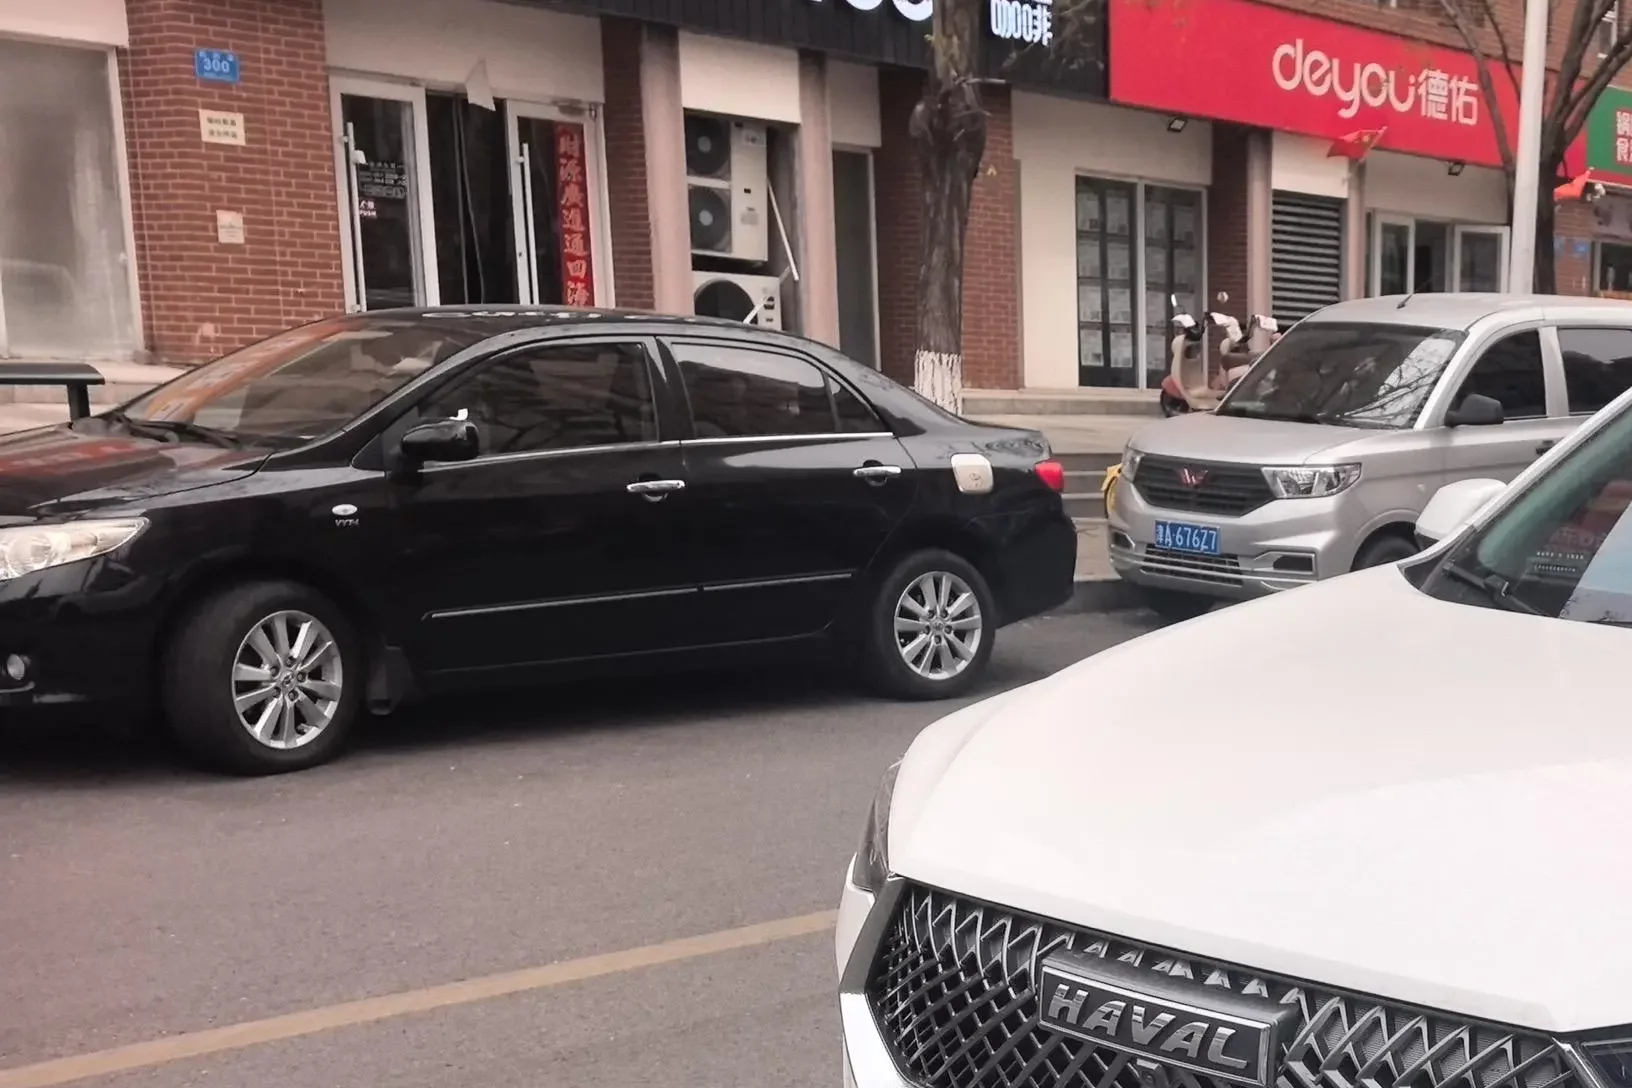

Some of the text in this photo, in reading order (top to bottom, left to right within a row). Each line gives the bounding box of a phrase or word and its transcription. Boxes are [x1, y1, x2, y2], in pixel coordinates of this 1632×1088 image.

[203, 57, 231, 73] 300
[1272, 38, 1415, 118] deyou
[1417, 69, 1479, 125] 德佑
[1048, 983, 1248, 1069] HAVAL
